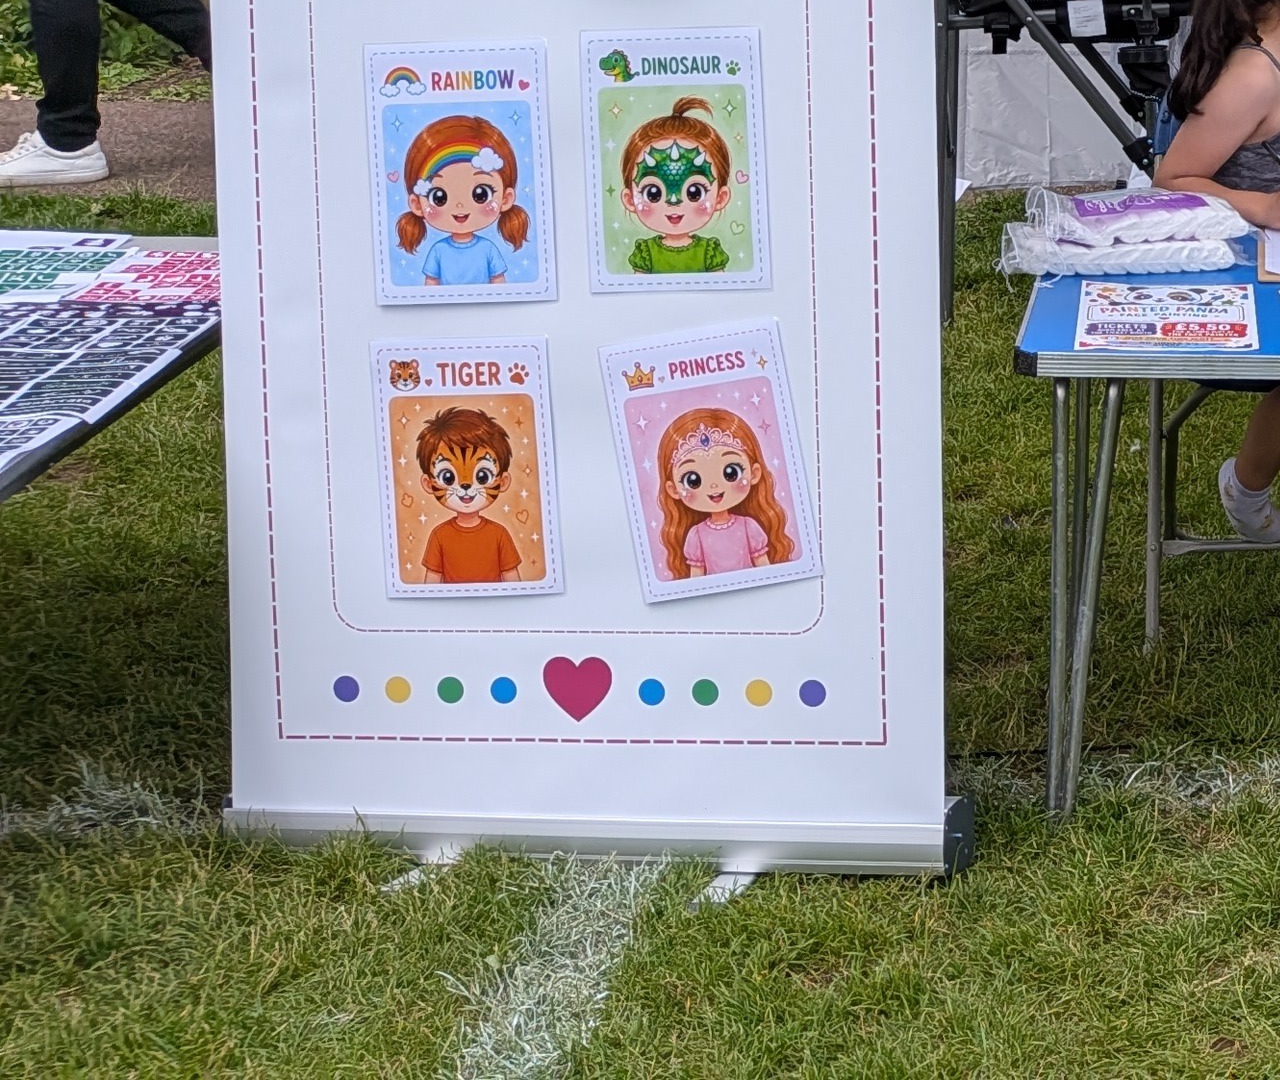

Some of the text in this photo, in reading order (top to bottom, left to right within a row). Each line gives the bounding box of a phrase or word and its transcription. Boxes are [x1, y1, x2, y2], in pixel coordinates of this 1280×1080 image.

[640, 55, 721, 76] DINOSAUR
[430, 69, 514, 93] RAINBOW
[1100, 305, 1229, 314] PAINTED PANDA
[1176, 323, 1232, 331] £5.50
[436, 362, 502, 388] TIGER
[668, 352, 746, 380] PRINCESS
